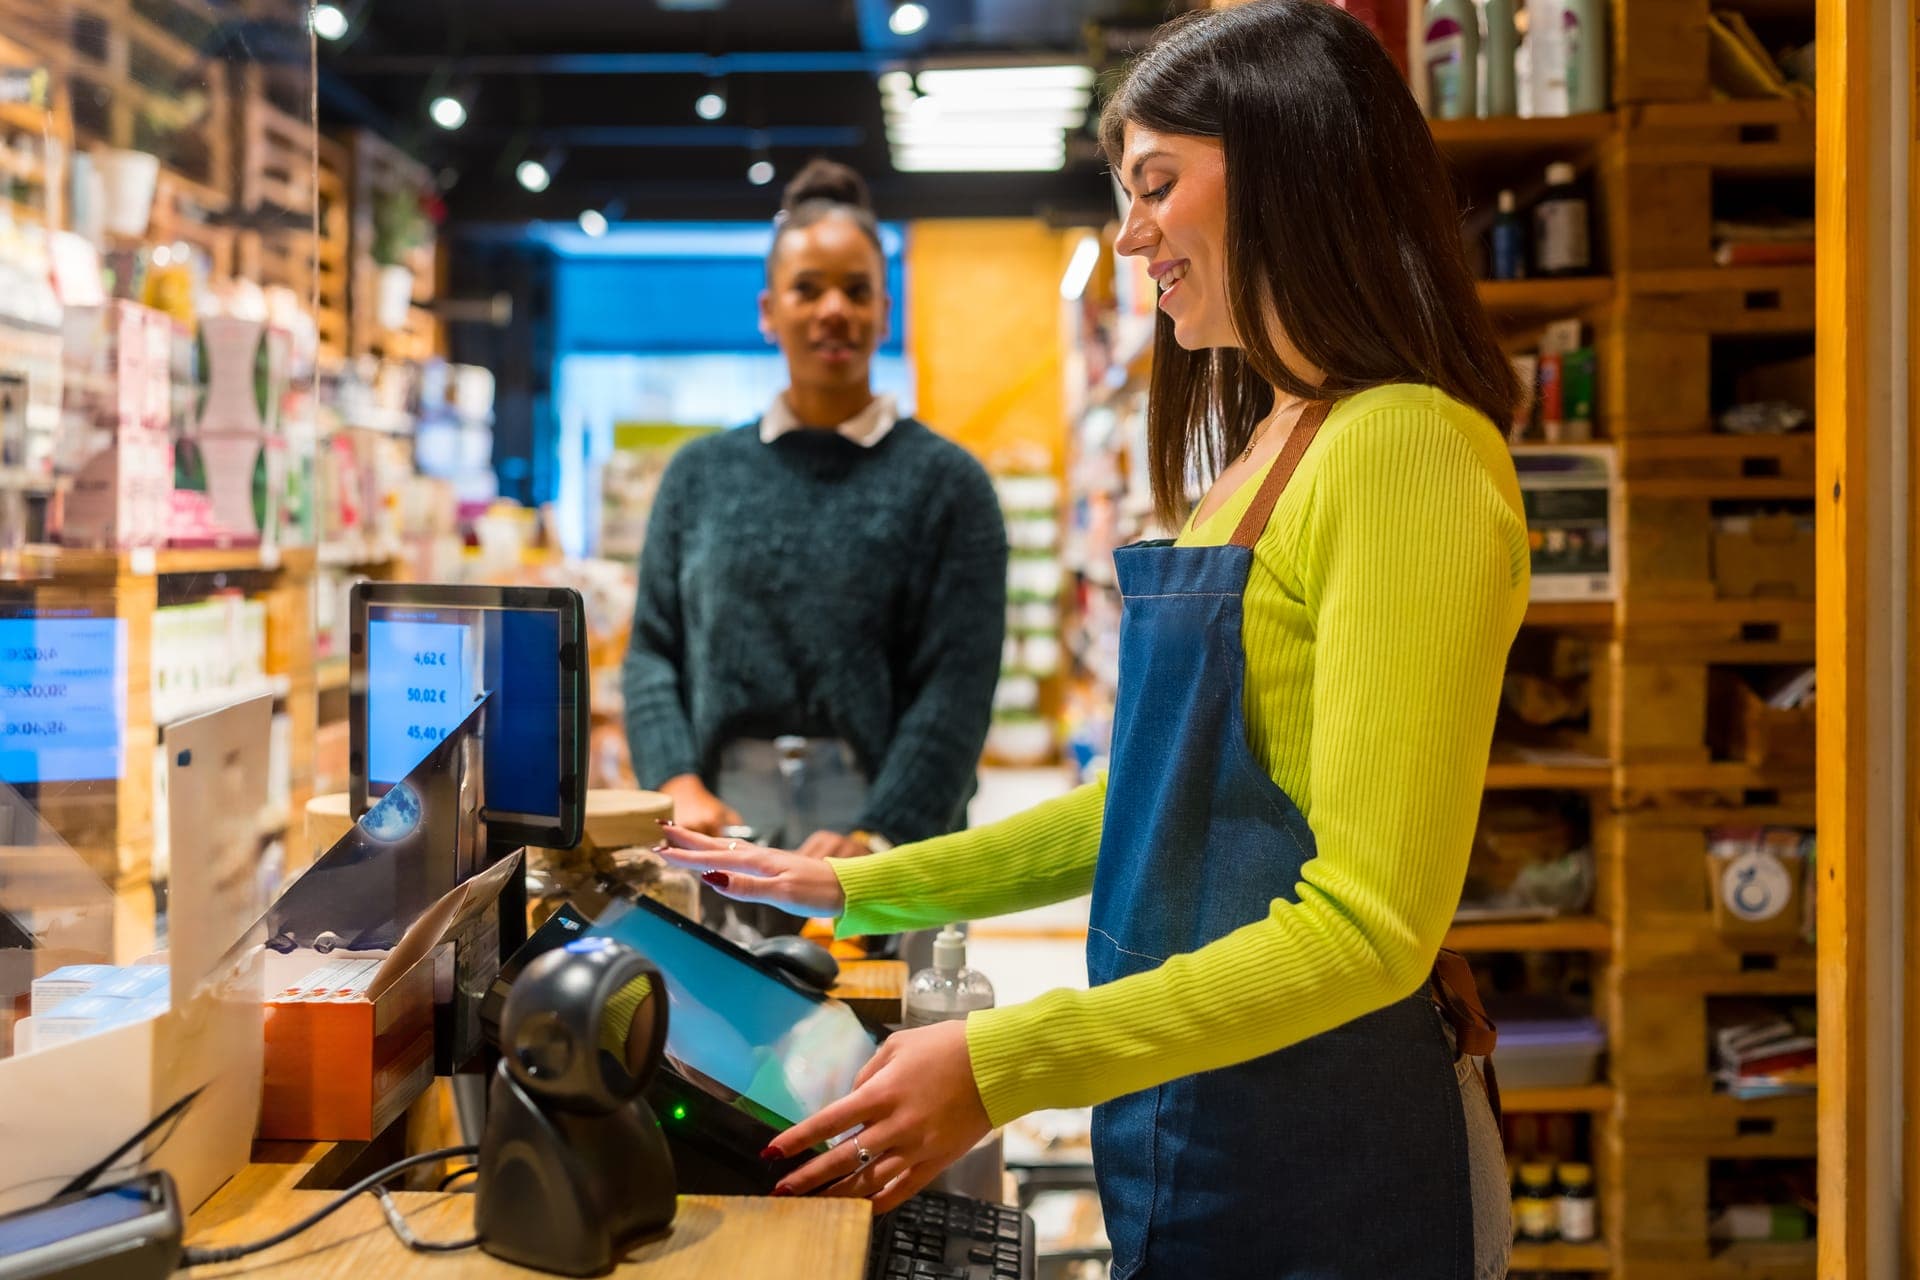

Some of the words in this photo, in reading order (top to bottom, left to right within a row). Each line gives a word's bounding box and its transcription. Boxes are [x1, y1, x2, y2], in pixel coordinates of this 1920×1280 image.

[413, 652, 437, 666] 4,62
[439, 653, 446, 666] €
[407, 688, 437, 703] 50,02
[439, 690, 446, 703] €
[407, 726, 437, 741] 45,40
[439, 727, 446, 740] €
